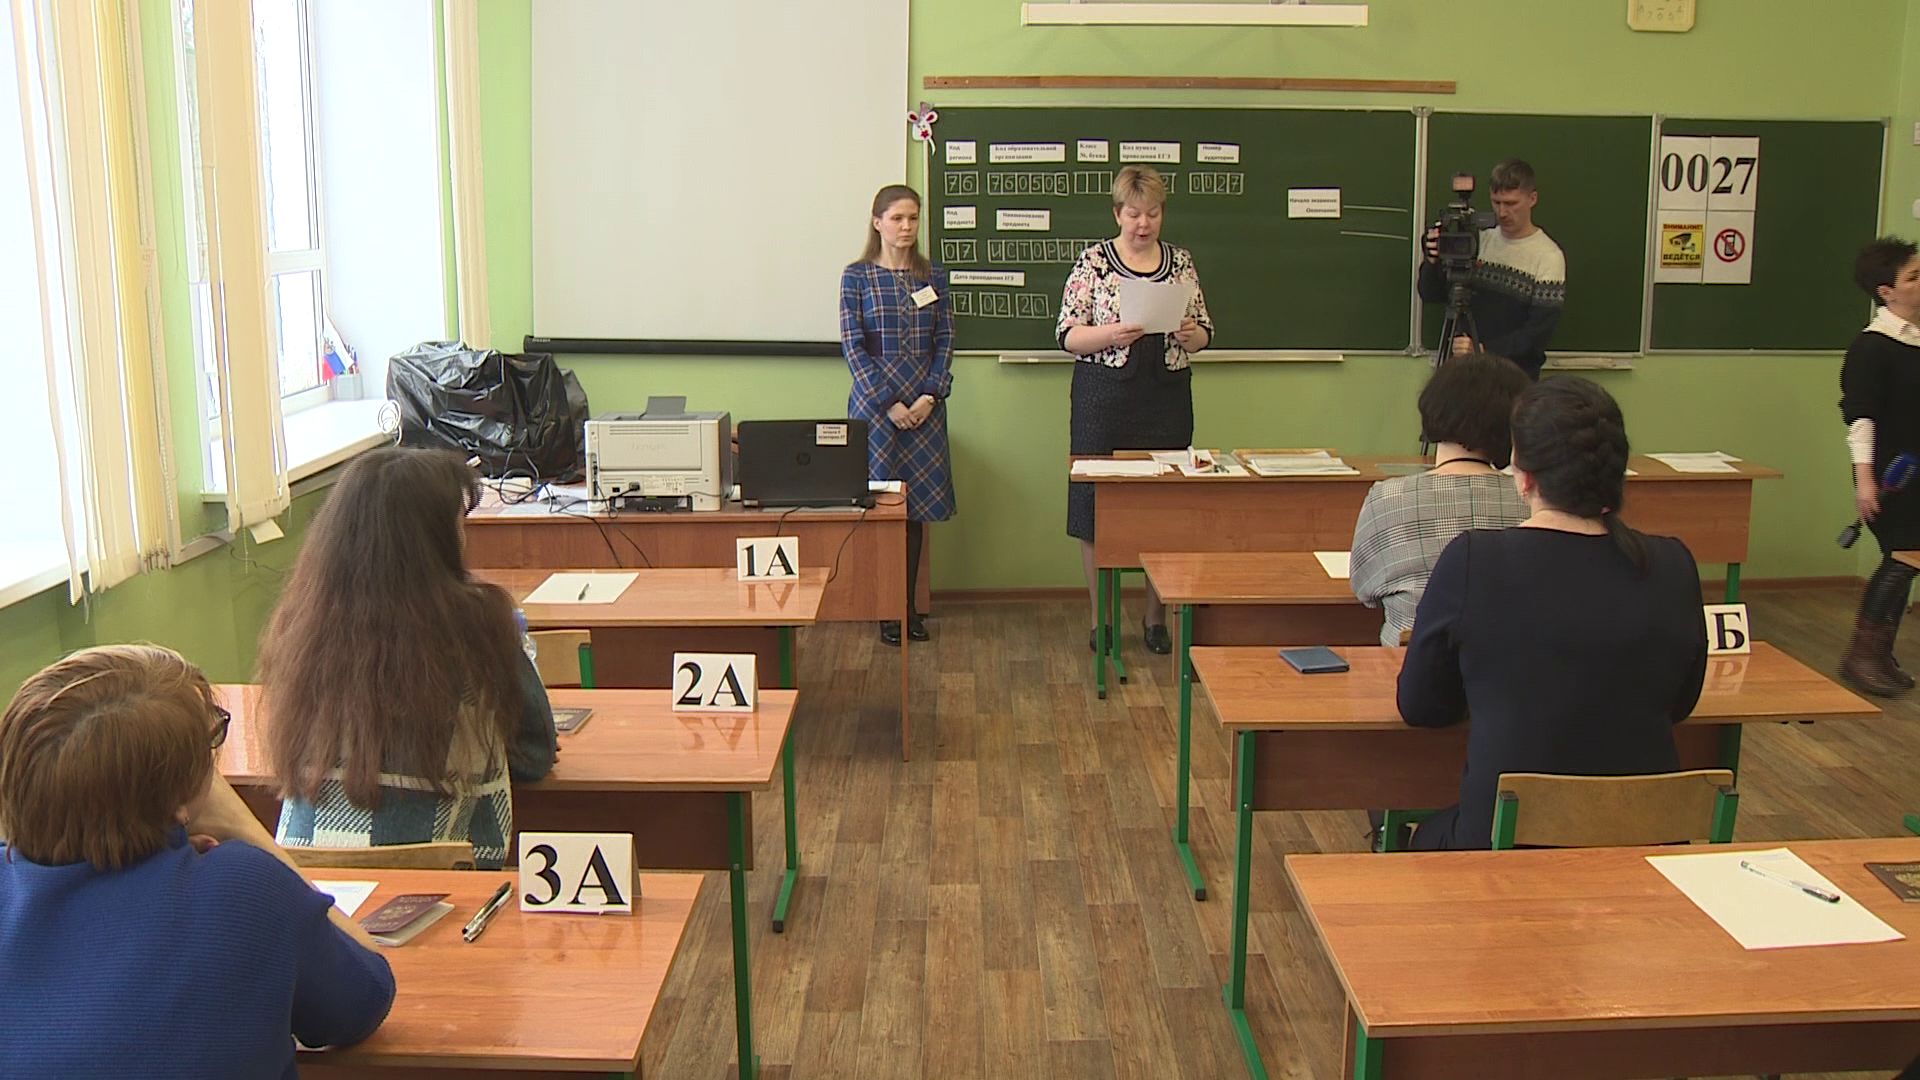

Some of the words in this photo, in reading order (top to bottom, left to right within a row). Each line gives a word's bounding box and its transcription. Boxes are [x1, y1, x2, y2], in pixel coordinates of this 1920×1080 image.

[1661, 152, 1757, 195] 0027
[946, 175, 973, 192] 76
[991, 174, 1066, 192] 760505
[944, 243, 971, 260] 07
[991, 243, 1083, 259] ИСТОРИЯ
